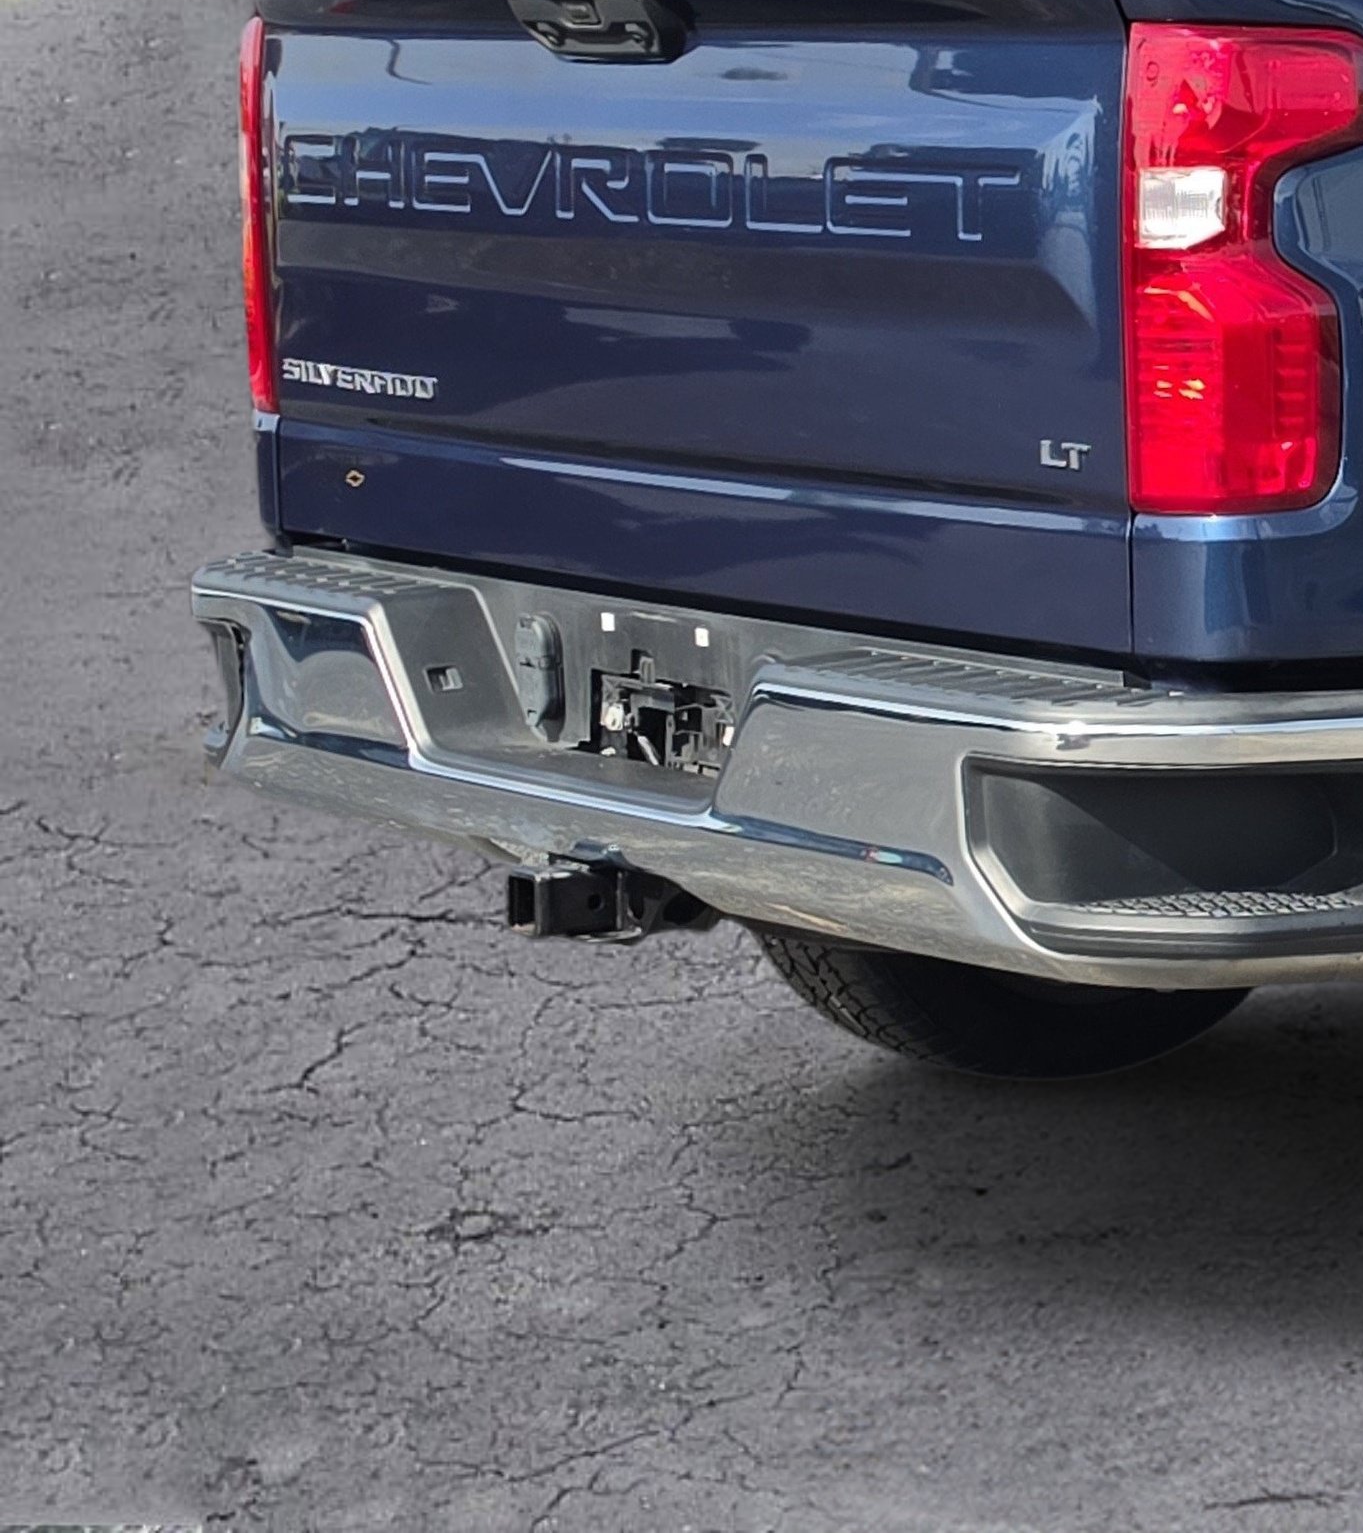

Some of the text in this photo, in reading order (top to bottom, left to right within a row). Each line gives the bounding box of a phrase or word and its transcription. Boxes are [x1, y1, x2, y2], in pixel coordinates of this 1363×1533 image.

[281, 132, 1021, 241] CHEVROLET
[282, 357, 439, 400] SILVERADO
[1040, 439, 1092, 471] LT
